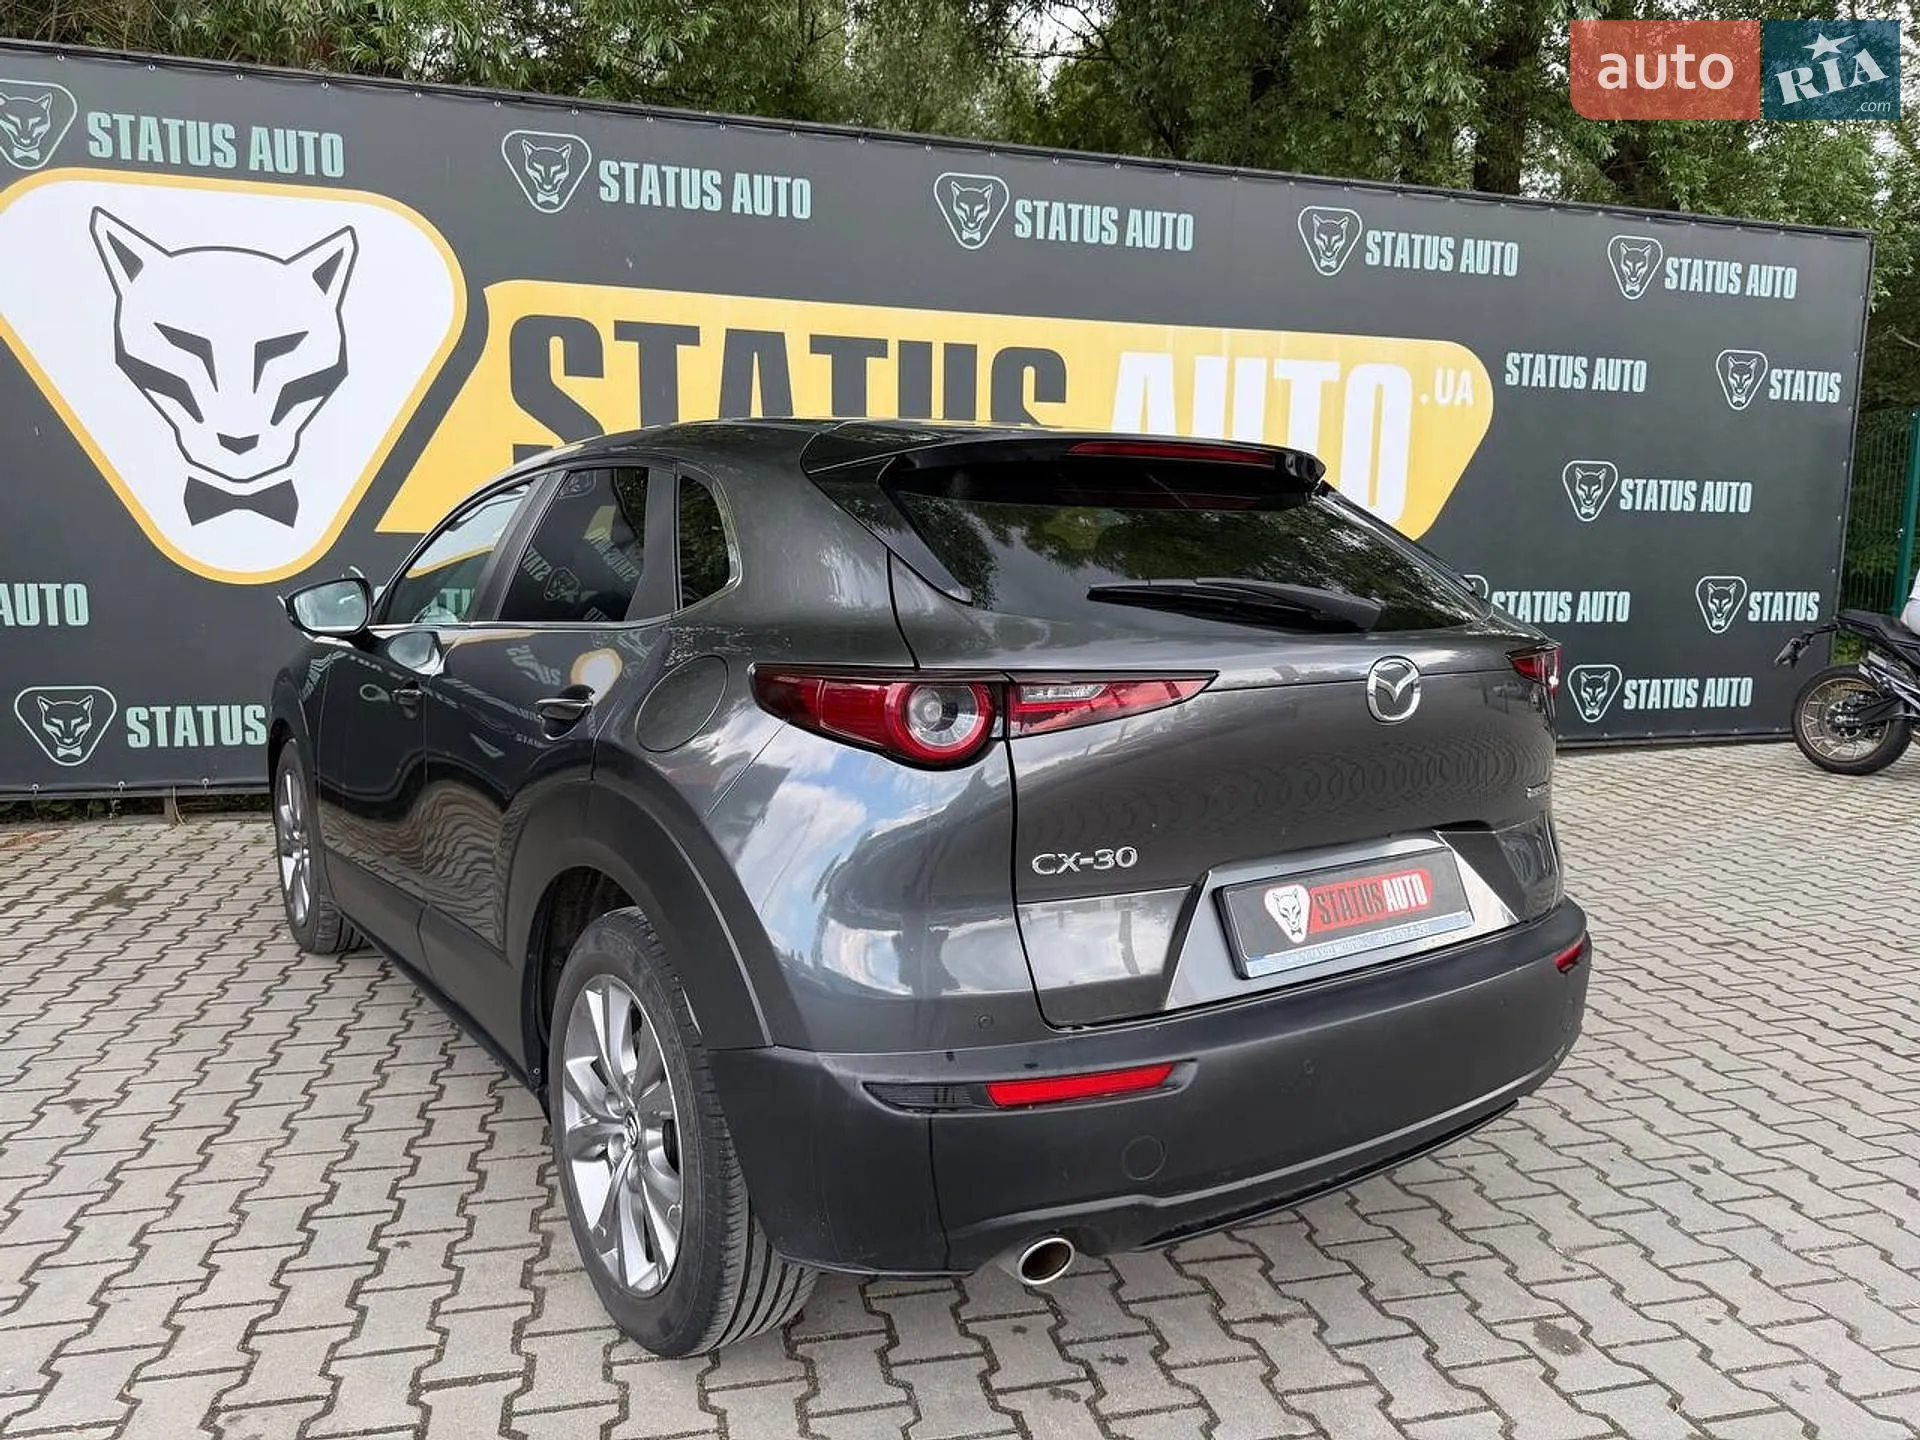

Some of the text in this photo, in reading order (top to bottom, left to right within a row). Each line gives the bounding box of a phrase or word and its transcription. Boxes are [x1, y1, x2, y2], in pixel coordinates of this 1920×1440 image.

[87, 111, 346, 178] STATUS AUTO
[599, 160, 812, 220] STATUS AUTO
[1014, 199, 1195, 252] STATUS AUTO
[1365, 229, 1519, 277] STATUS AUTO
[1664, 256, 1799, 300] STATUS AUTO
[1504, 352, 1648, 393] STATUS AUTO
[1767, 367, 1842, 403] STATUS
[1618, 478, 1753, 514] STATUS AUTO
[1576, 591, 1632, 623] AUTO
[1747, 590, 1821, 622] STATUS
[1622, 676, 1753, 710] STATUS AUTO
[126, 704, 268, 749] STATUS
[1031, 846, 1138, 875] CX-30
[1314, 872, 1428, 926] STATUS AUTO
